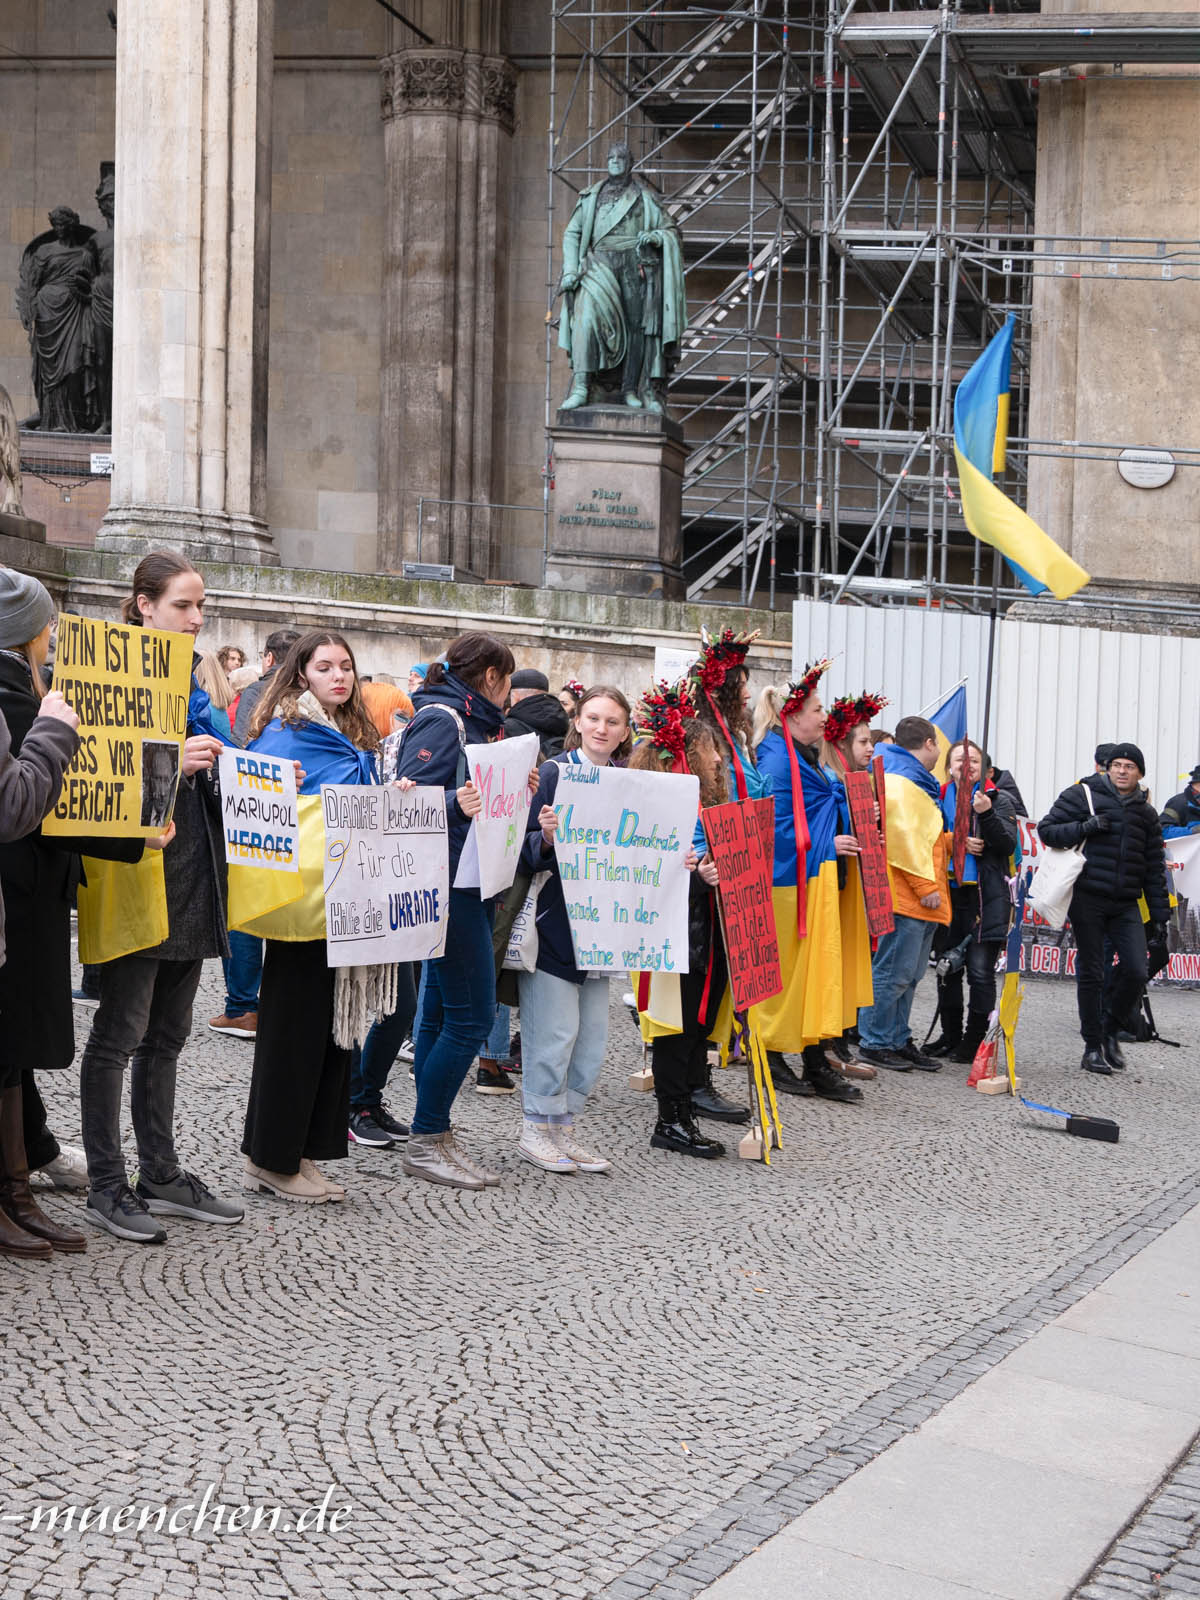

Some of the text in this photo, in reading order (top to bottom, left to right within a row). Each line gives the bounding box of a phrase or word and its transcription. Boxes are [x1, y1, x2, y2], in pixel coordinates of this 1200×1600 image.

[158, 691, 187, 735] UND
[107, 738, 135, 776] VOR
[235, 757, 283, 794] FREE
[225, 795, 297, 828] MARIUPOL
[382, 790, 446, 831] Deutschland
[475, 763, 515, 822] Make
[554, 804, 611, 844] Unsere
[707, 811, 737, 847] Jeden
[736, 800, 762, 859] Tag
[227, 828, 294, 864] HEROES
[358, 840, 416, 880] für die
[559, 847, 663, 887] und Friden wird
[364, 899, 383, 934] die
[614, 901, 628, 923] in
[634, 897, 660, 925] der
[1031, 945, 1060, 973] DER
